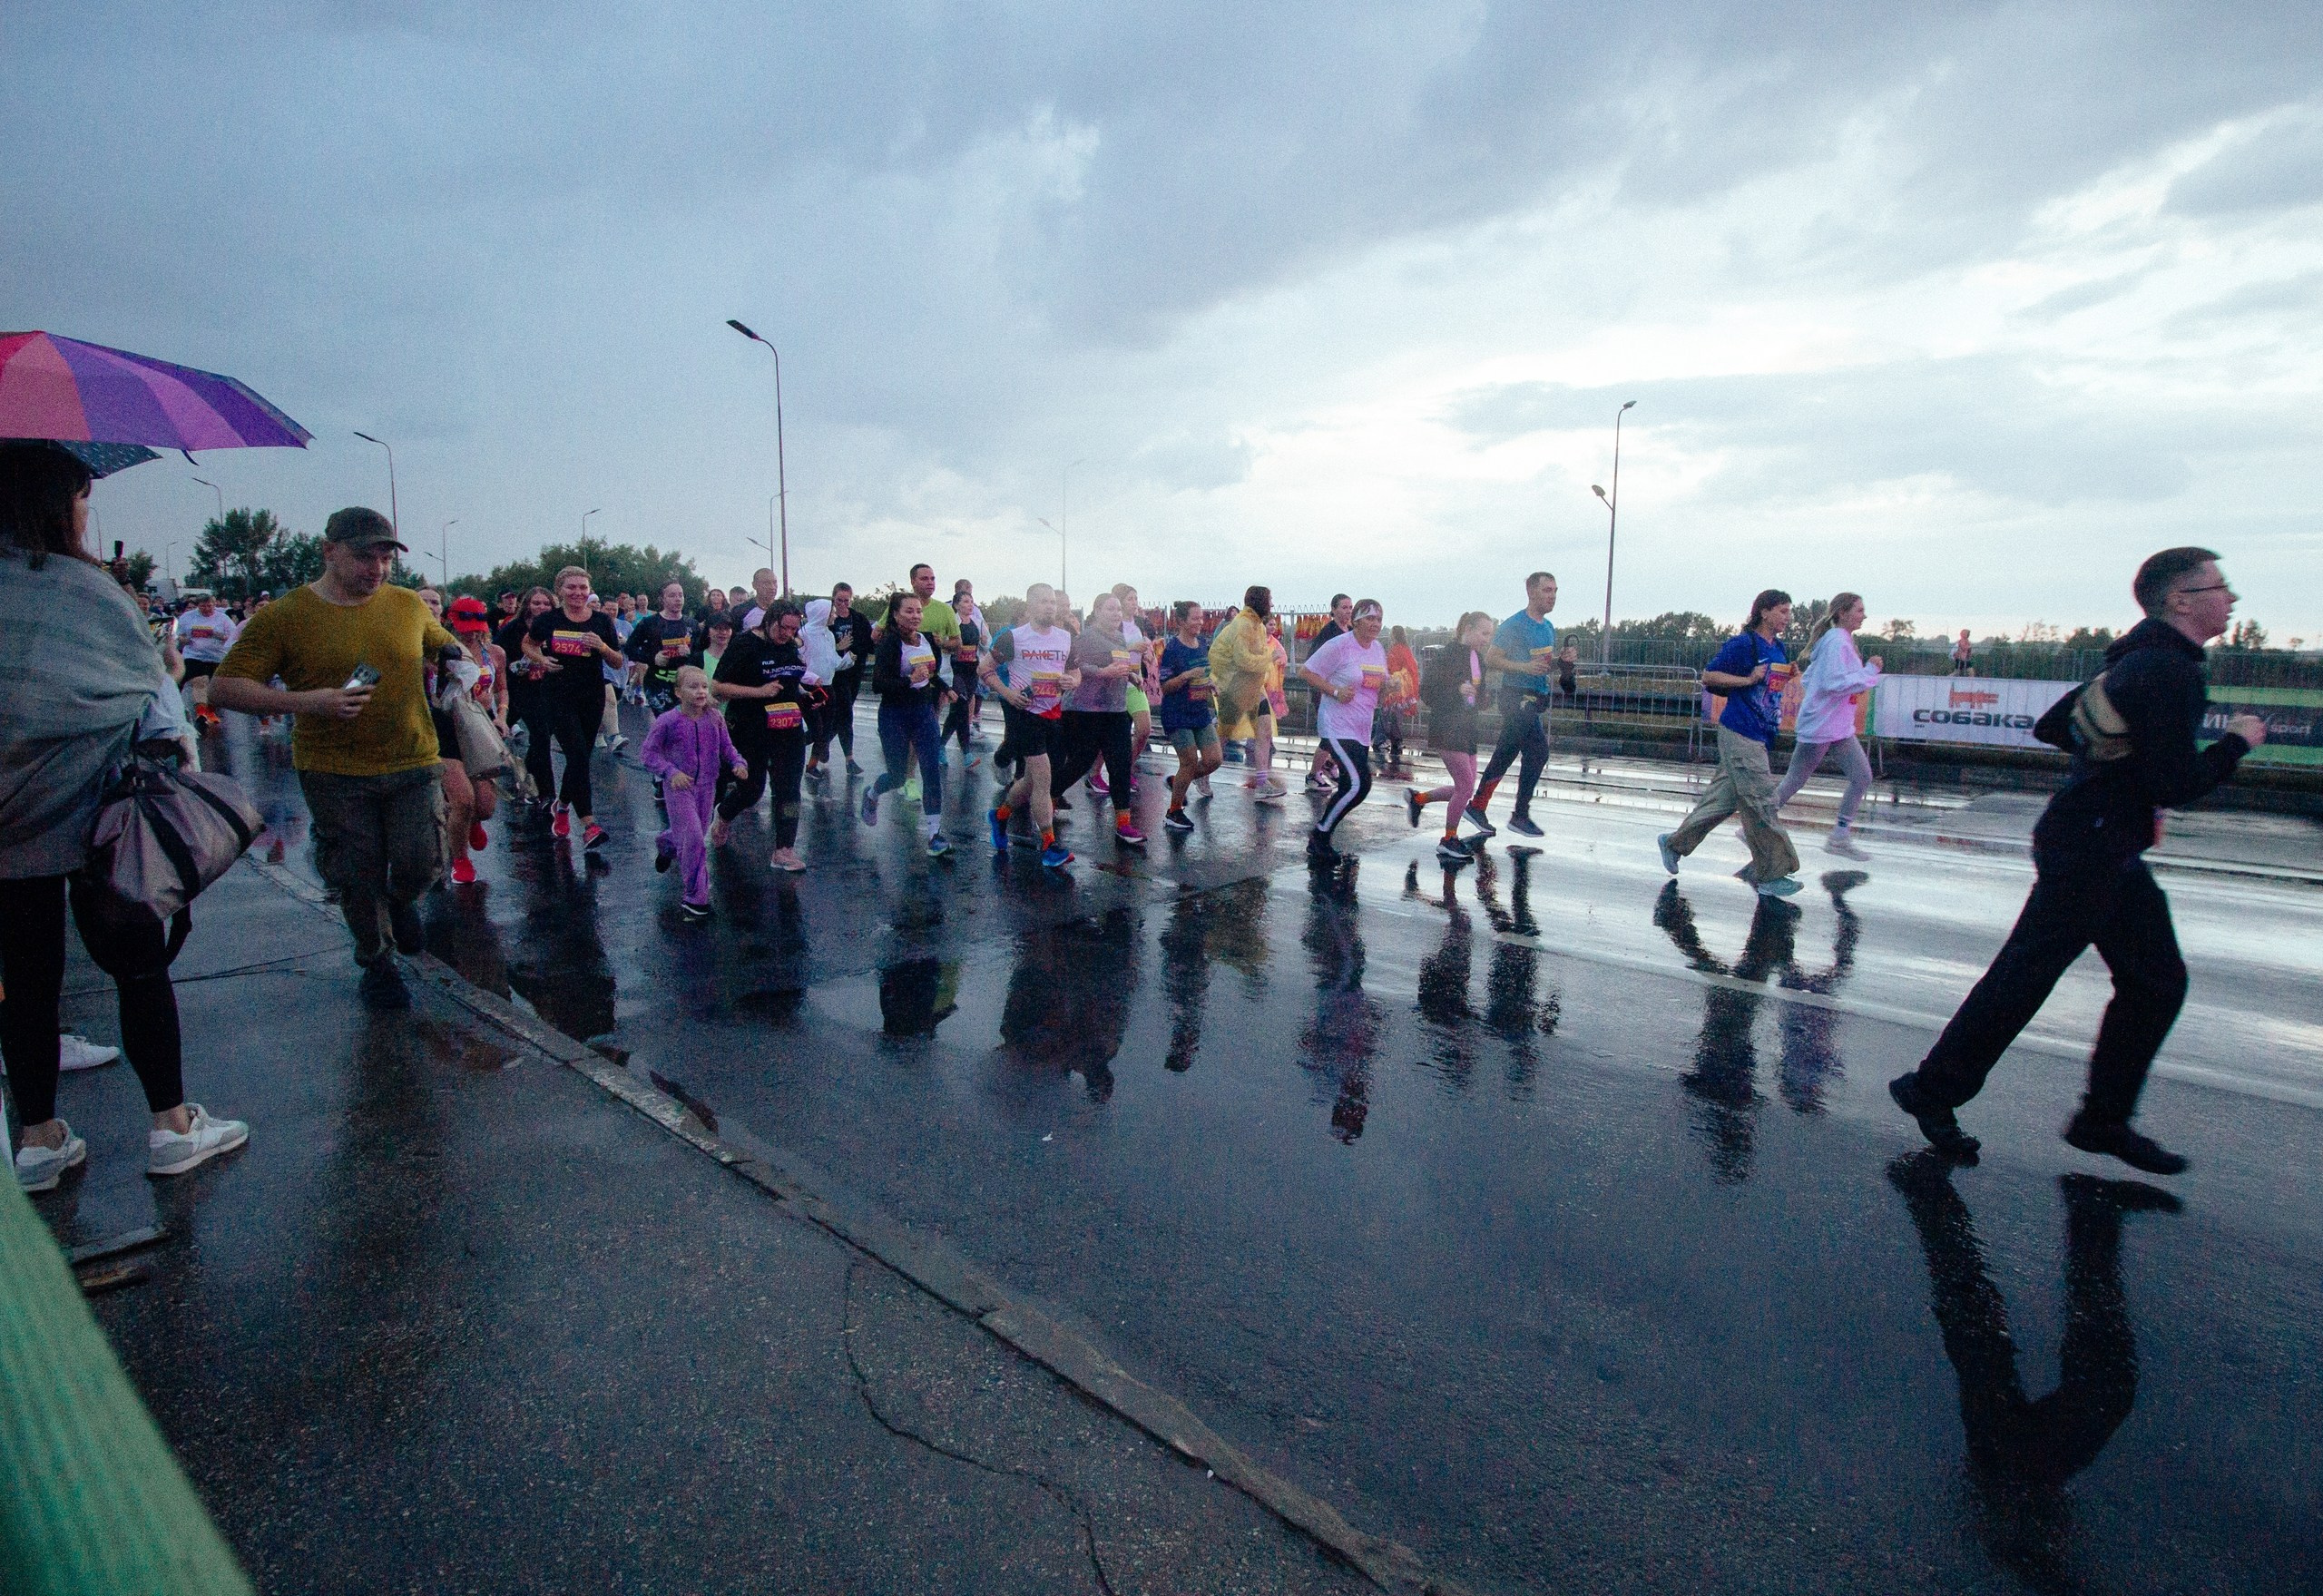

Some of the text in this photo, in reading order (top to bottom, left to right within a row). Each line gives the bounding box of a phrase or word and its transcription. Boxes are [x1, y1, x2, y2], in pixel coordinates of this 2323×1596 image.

[554, 642, 582, 654] 2574
[762, 665, 807, 675] N.NOVGORO
[769, 717, 794, 729] 2307
[2269, 723, 2311, 736] sport
